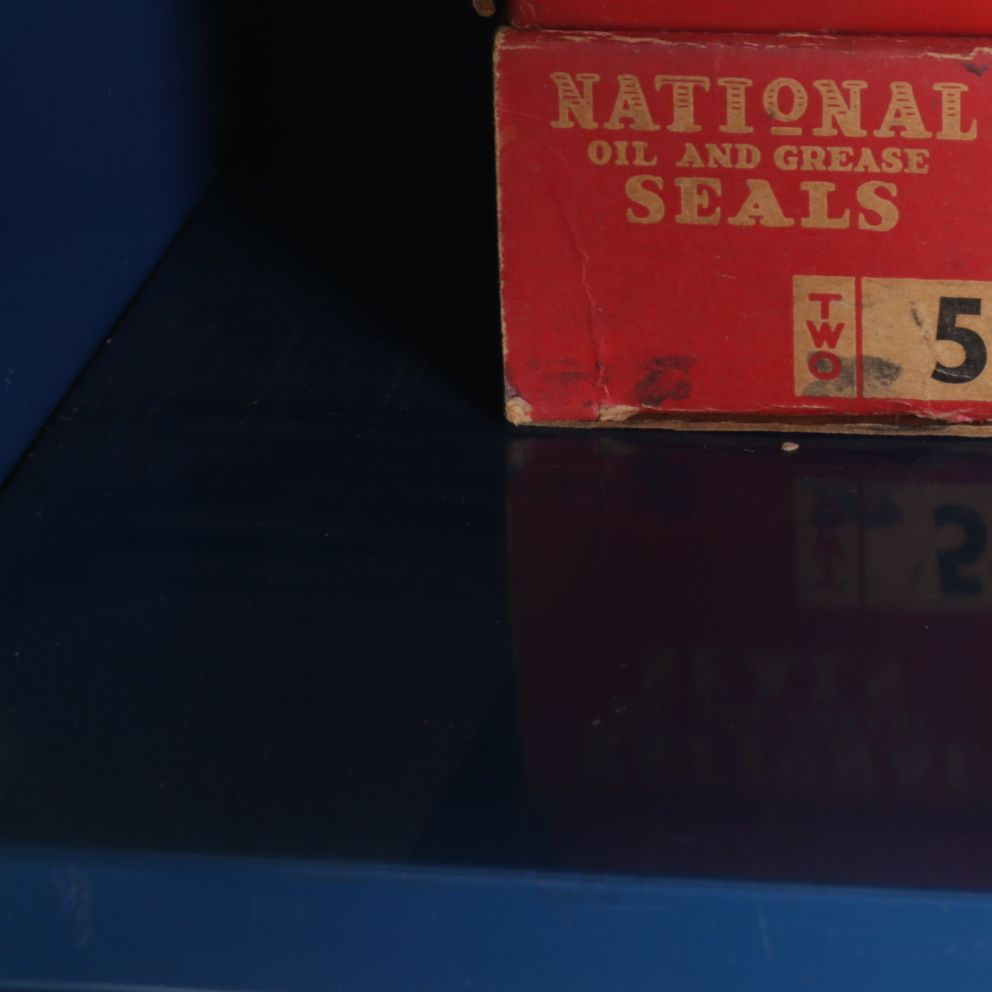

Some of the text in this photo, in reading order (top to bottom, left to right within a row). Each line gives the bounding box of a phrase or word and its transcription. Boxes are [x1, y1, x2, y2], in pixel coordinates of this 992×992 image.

[549, 71, 979, 142] NATIONAL
[587, 139, 931, 176] OIL AND GREASE
[625, 176, 902, 234] SEALS
[806, 292, 846, 381] TWO
